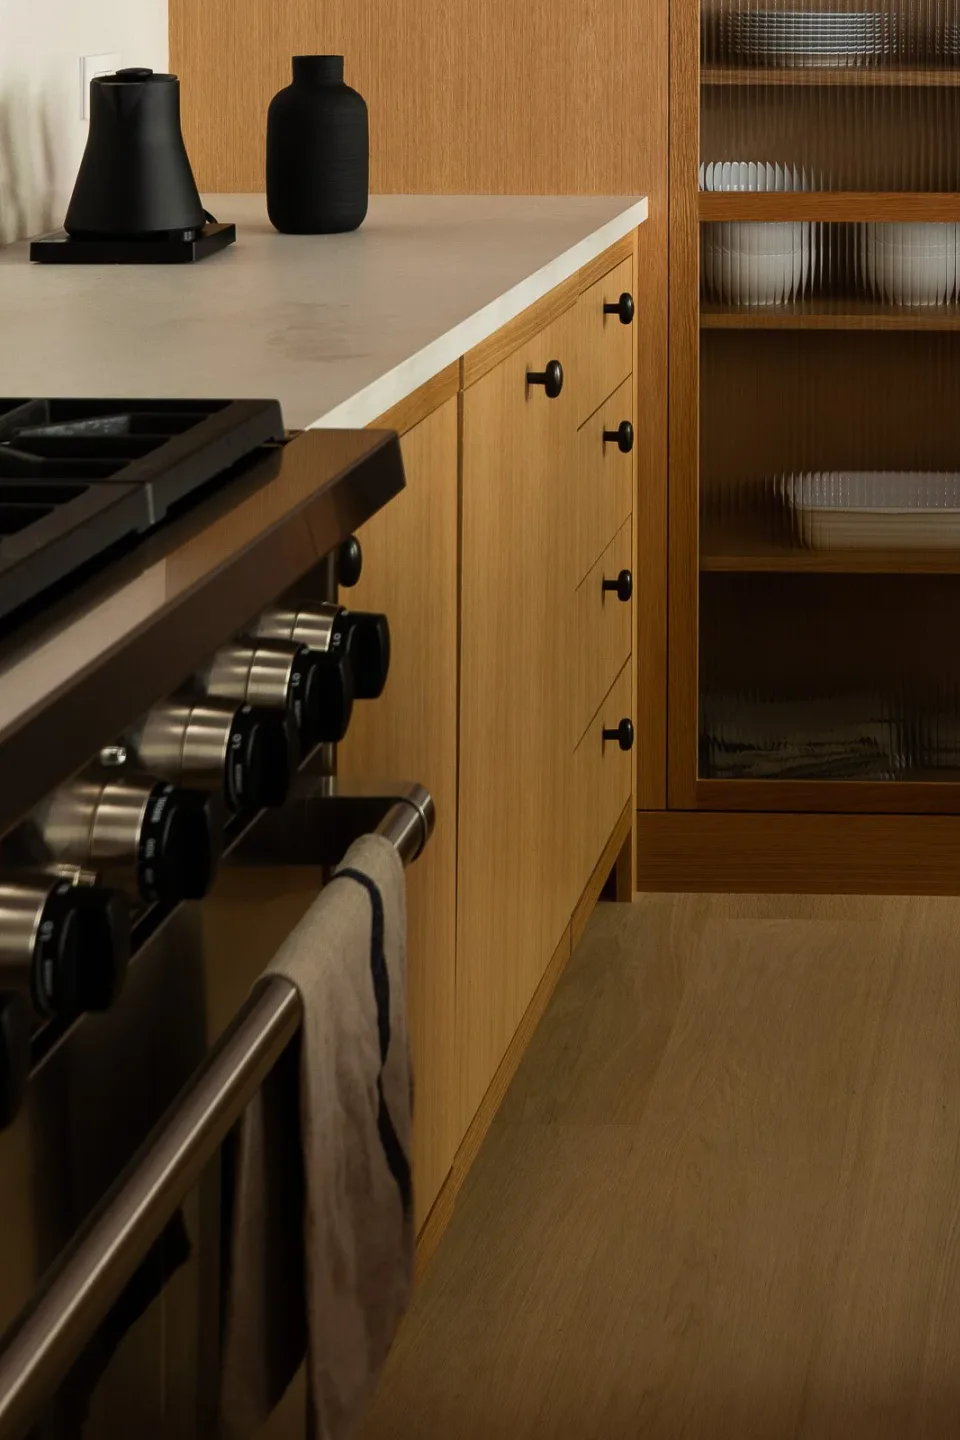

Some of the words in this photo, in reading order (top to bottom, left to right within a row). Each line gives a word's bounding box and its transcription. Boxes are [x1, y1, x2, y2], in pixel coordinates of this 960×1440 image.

[334, 632, 341, 646] LO
[292, 672, 300, 686] LO
[232, 734, 242, 749] LO
